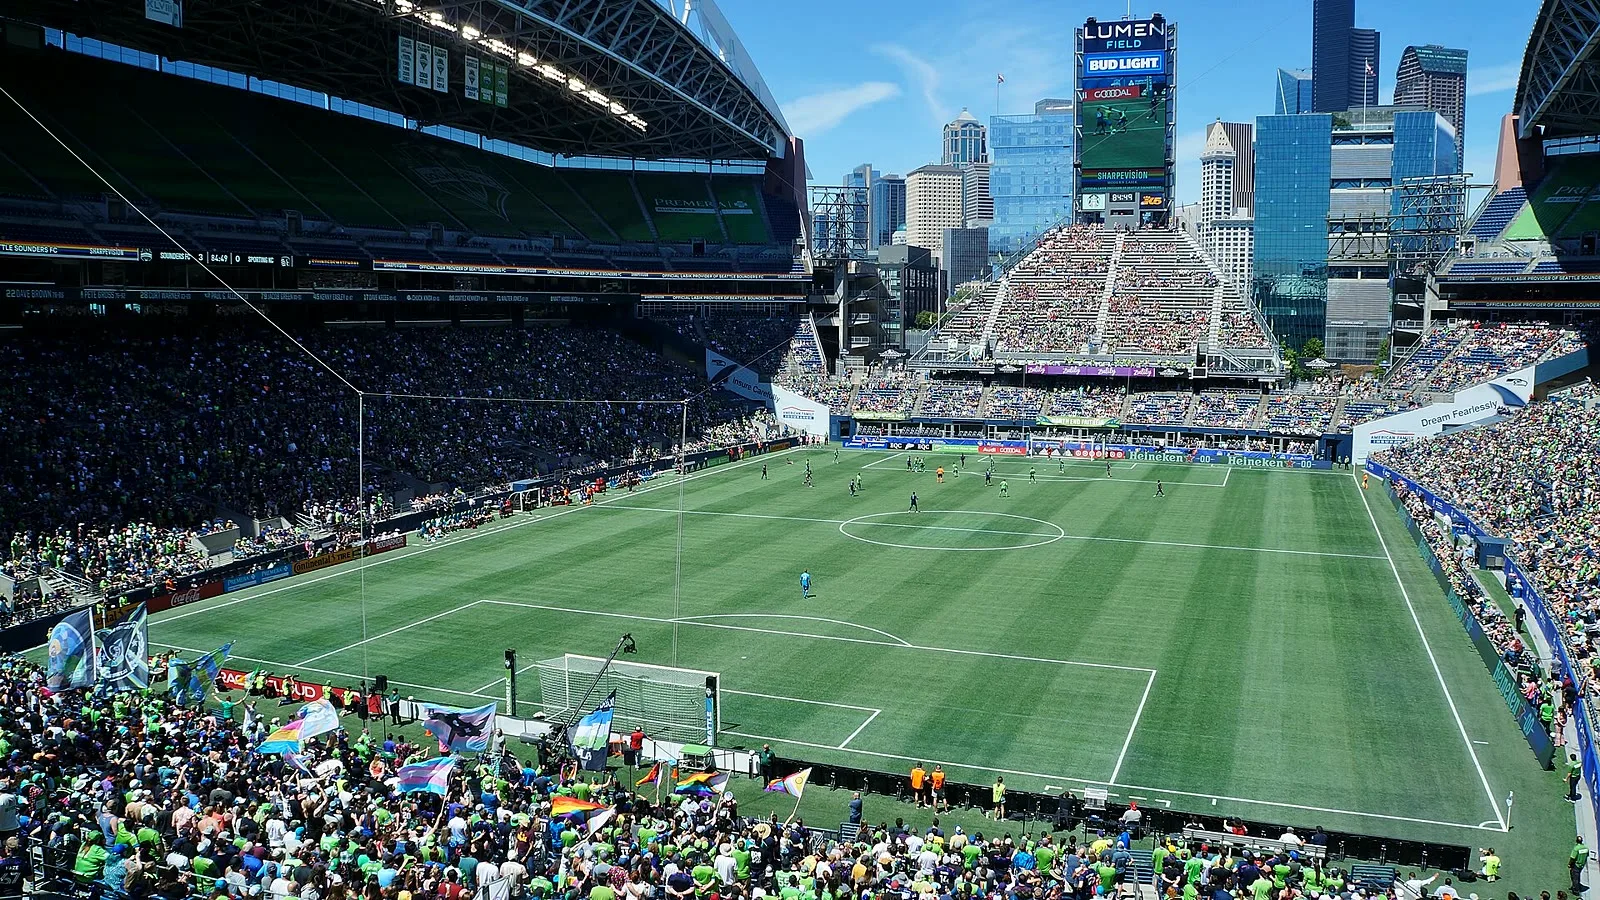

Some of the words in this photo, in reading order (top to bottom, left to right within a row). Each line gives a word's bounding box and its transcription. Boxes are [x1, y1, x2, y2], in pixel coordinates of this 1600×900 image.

[1085, 22, 1164, 39] LUMEN
[1106, 40, 1142, 49] FIELD
[1089, 60, 1118, 71] BUD
[1119, 57, 1158, 70] LIGHT
[1112, 193, 1133, 202] 84:49
[14, 244, 49, 253] SOUNDERS
[160, 252, 184, 260] SOUNDERS
[198, 253, 204, 261] 3
[235, 255, 241, 263] 0
[732, 376, 752, 391] Insure
[752, 384, 781, 404] Carefully
[1420, 411, 1450, 428] Dream
[1452, 399, 1498, 420] Fearlessly
[1129, 451, 1183, 463] Heineken
[1228, 456, 1284, 468] Heineken
[294, 555, 331, 573] Continental
[337, 551, 351, 560] TIRE
[1492, 659, 1521, 716] Heineken
